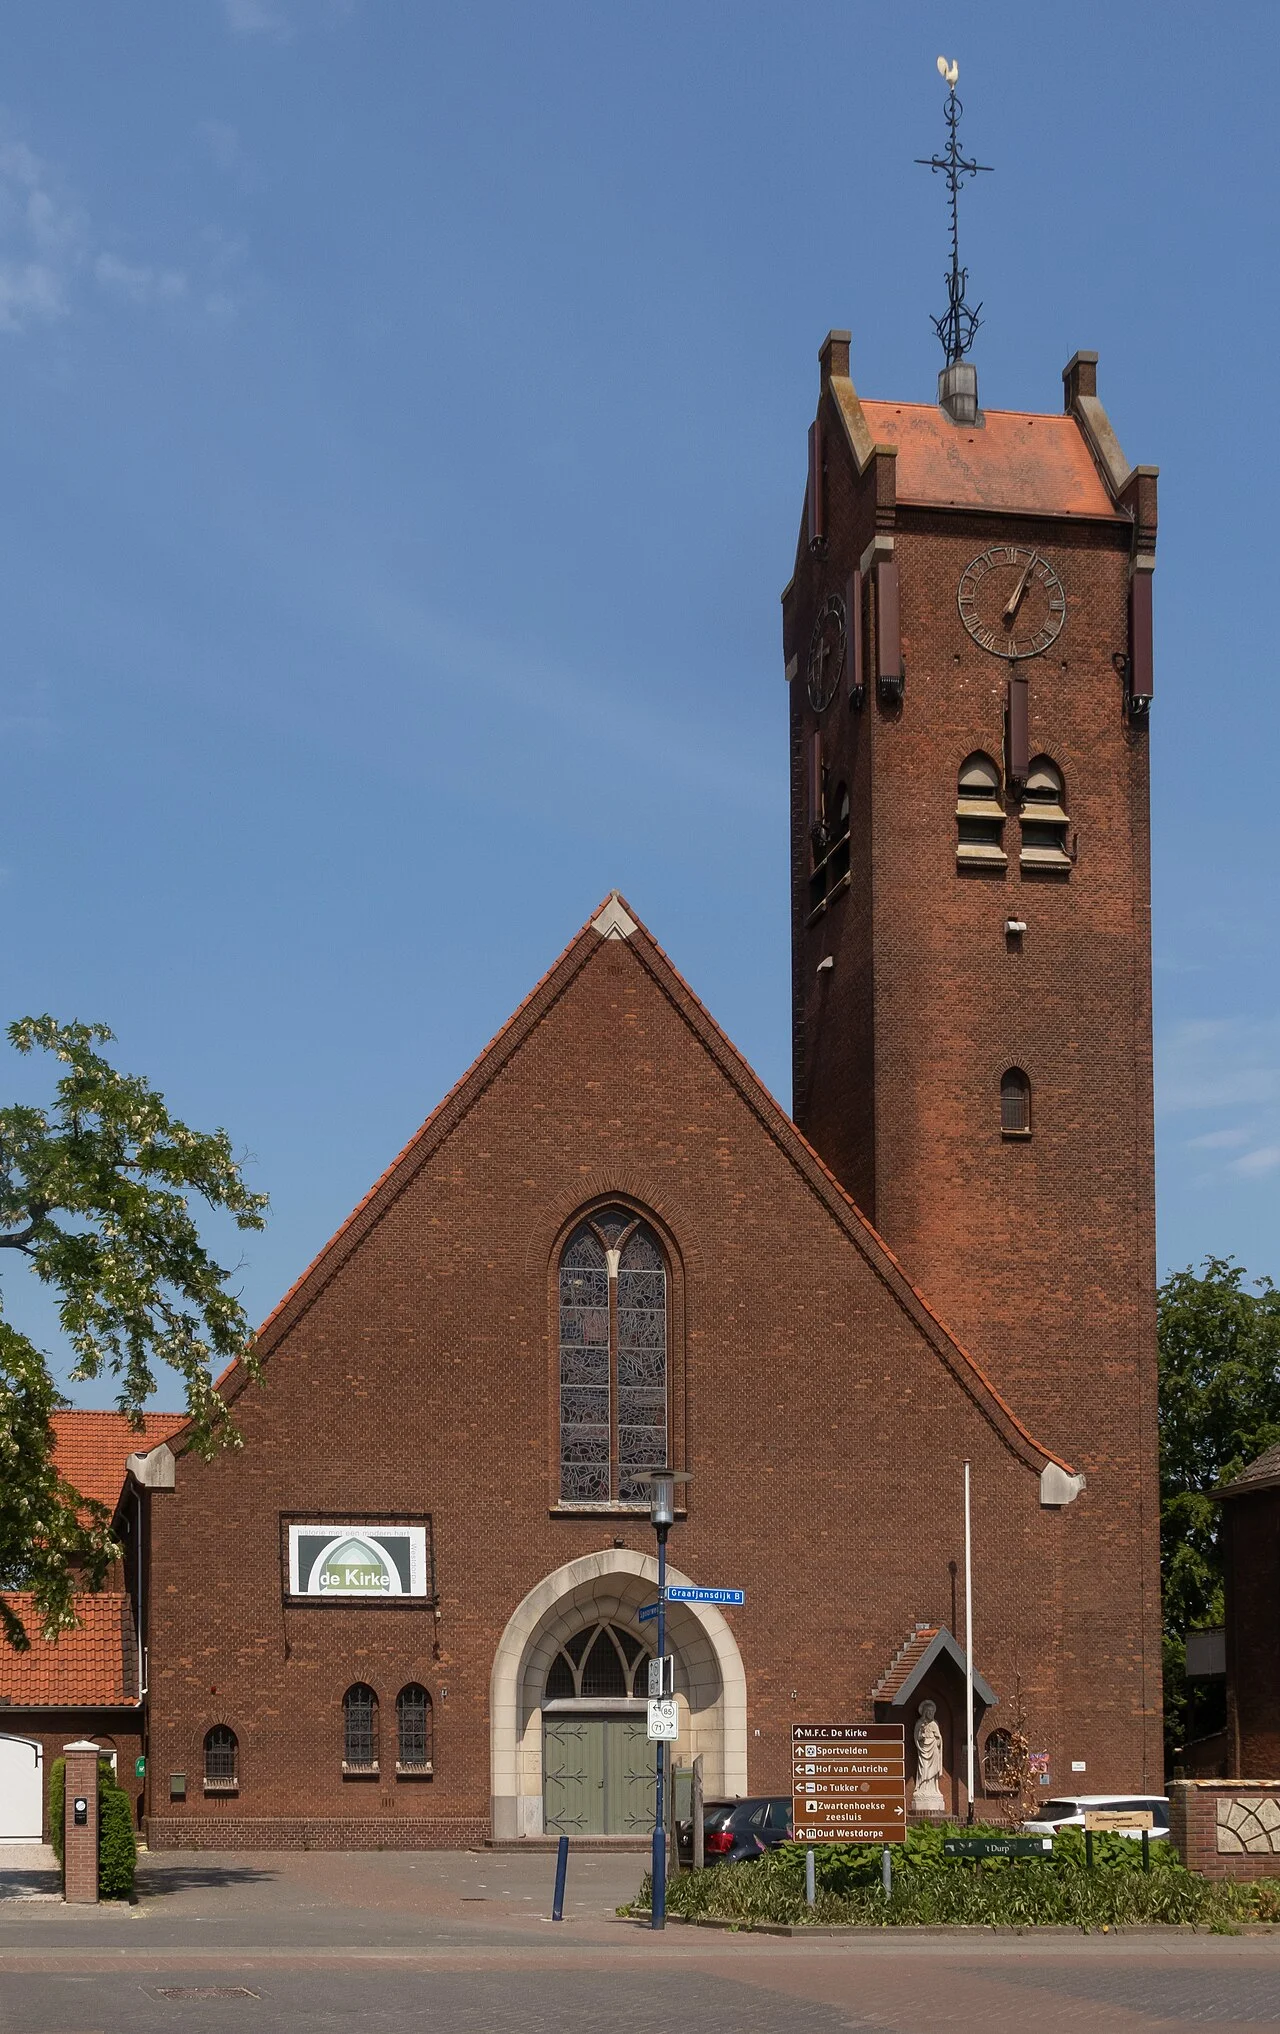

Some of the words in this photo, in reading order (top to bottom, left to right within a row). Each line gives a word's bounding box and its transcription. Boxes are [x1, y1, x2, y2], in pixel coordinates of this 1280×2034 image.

[320, 1572, 340, 1586] de
[345, 1568, 390, 1586] Kirke
[671, 1589, 731, 1601] Graafjansdijk
[734, 1592, 740, 1600] B
[663, 1707, 673, 1715] 85
[655, 1724, 662, 1732] 71
[804, 1729, 829, 1737] M.F.C.
[831, 1729, 842, 1737] De
[845, 1728, 868, 1737] Kirke
[817, 1746, 868, 1756] Sportvelden
[816, 1765, 831, 1773] Hof
[851, 1765, 889, 1773] Autriche
[817, 1784, 828, 1792] De
[830, 1783, 859, 1792] Tukker
[818, 1801, 886, 1810] Zwartenhoekse
[825, 1812, 862, 1821] zeesluis
[817, 1829, 834, 1837] Oud
[836, 1829, 884, 1838] Westdorpe
[991, 1844, 1010, 1854] Durp
